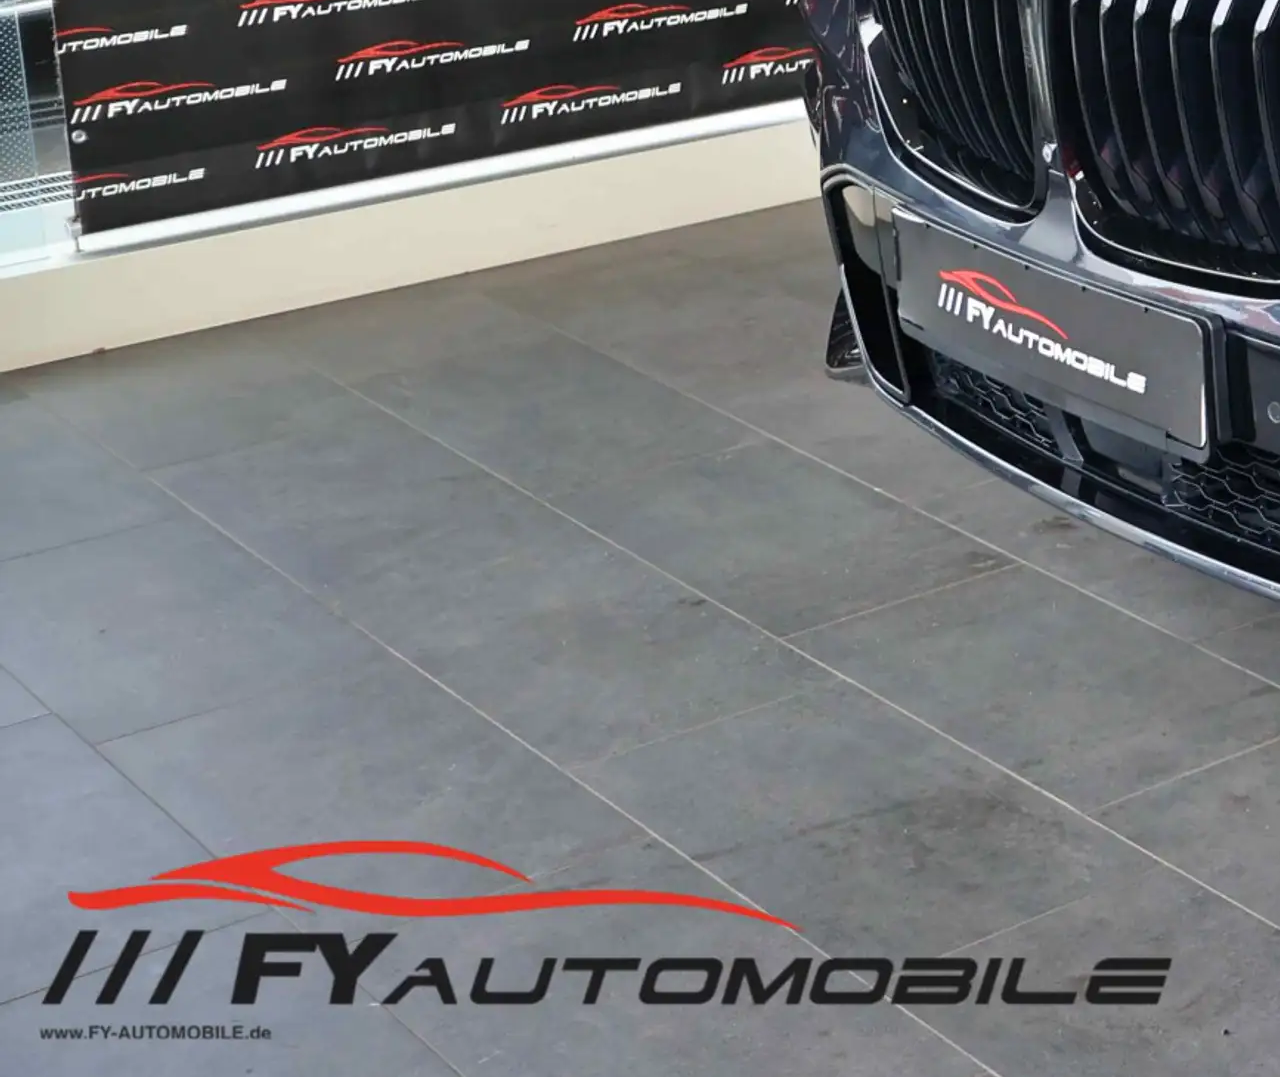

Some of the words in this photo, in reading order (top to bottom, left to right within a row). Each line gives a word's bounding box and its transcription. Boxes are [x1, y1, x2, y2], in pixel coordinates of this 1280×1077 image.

[603, 4, 748, 36] FYAUTOMOBILE
[368, 40, 529, 75] FYAUTOMOBILE
[108, 79, 287, 118] FYAUTOMOBILE
[532, 83, 681, 119] FYAUTOMOBILE
[290, 123, 455, 163] FYAUTOMOBILE
[967, 296, 1147, 394] FYAUTOMOBILE
